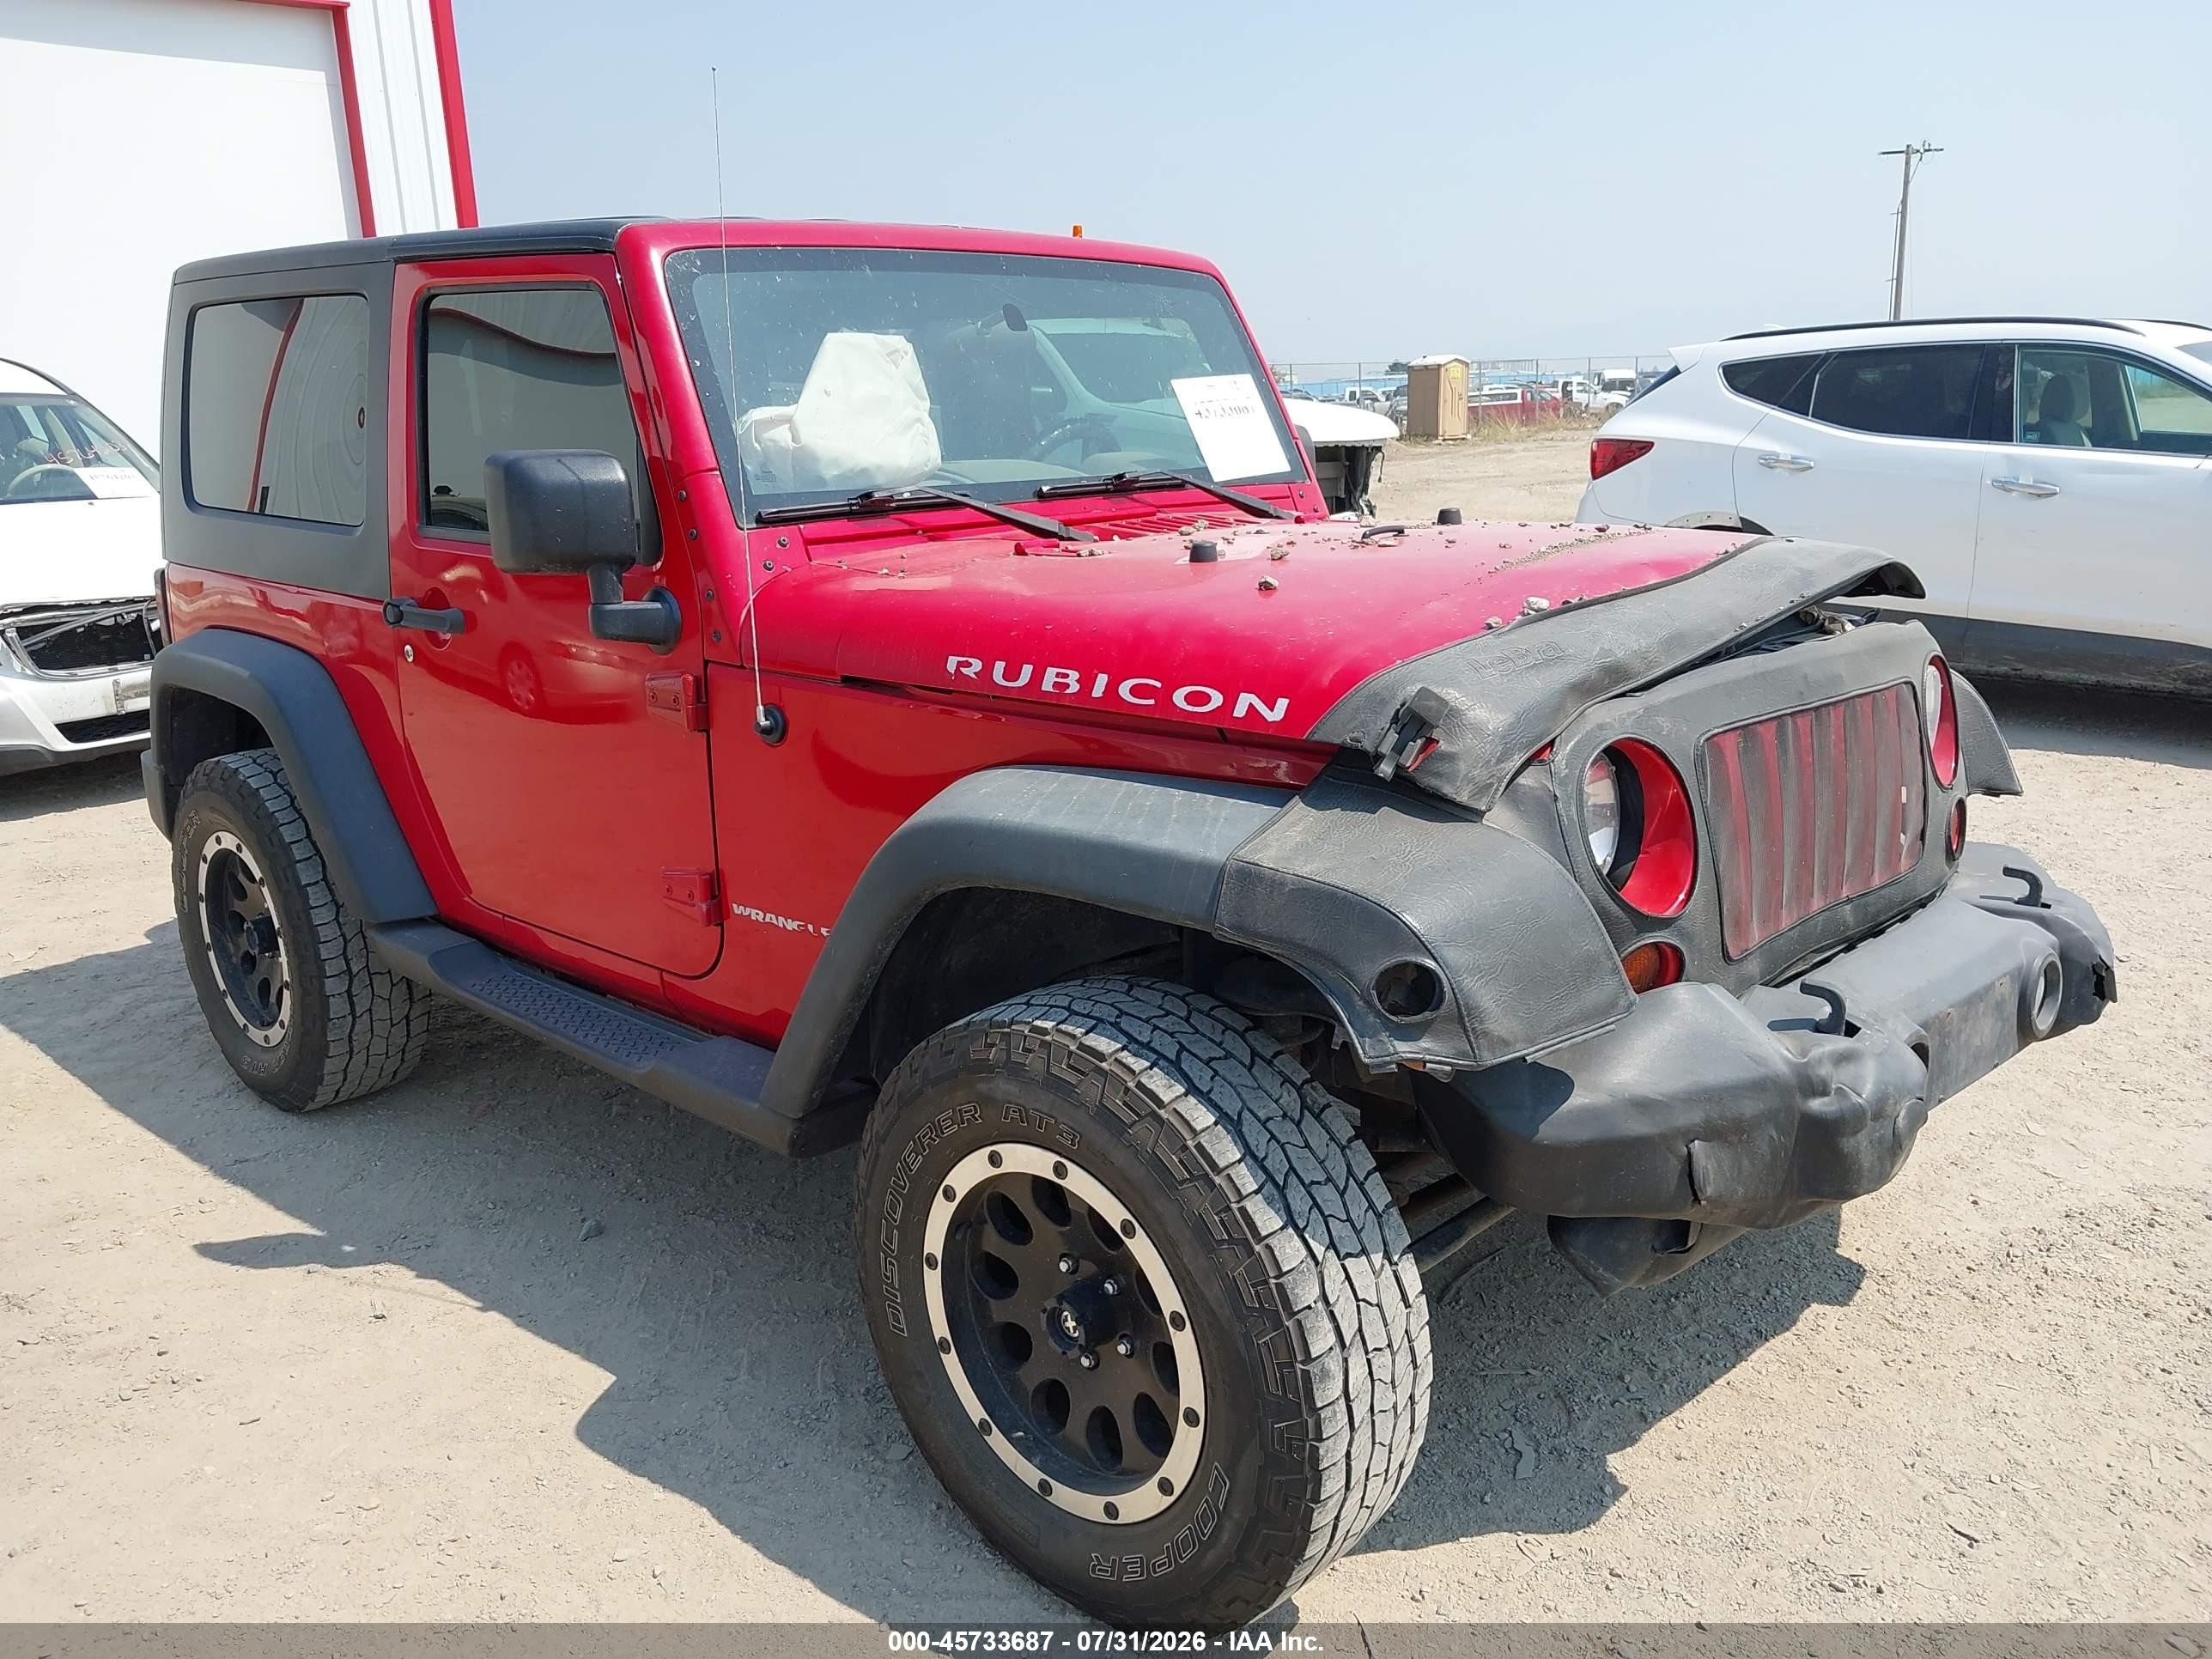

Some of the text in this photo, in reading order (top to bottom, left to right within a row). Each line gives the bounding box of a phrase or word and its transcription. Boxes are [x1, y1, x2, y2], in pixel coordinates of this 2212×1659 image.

[946, 655, 1290, 722] RUBICON
[1464, 641, 1565, 680] LeBra
[732, 902, 832, 937] WRANGLE
[880, 1102, 1083, 1338] DISCOVERER AT3
[1089, 1462, 1230, 1582] COOPER
